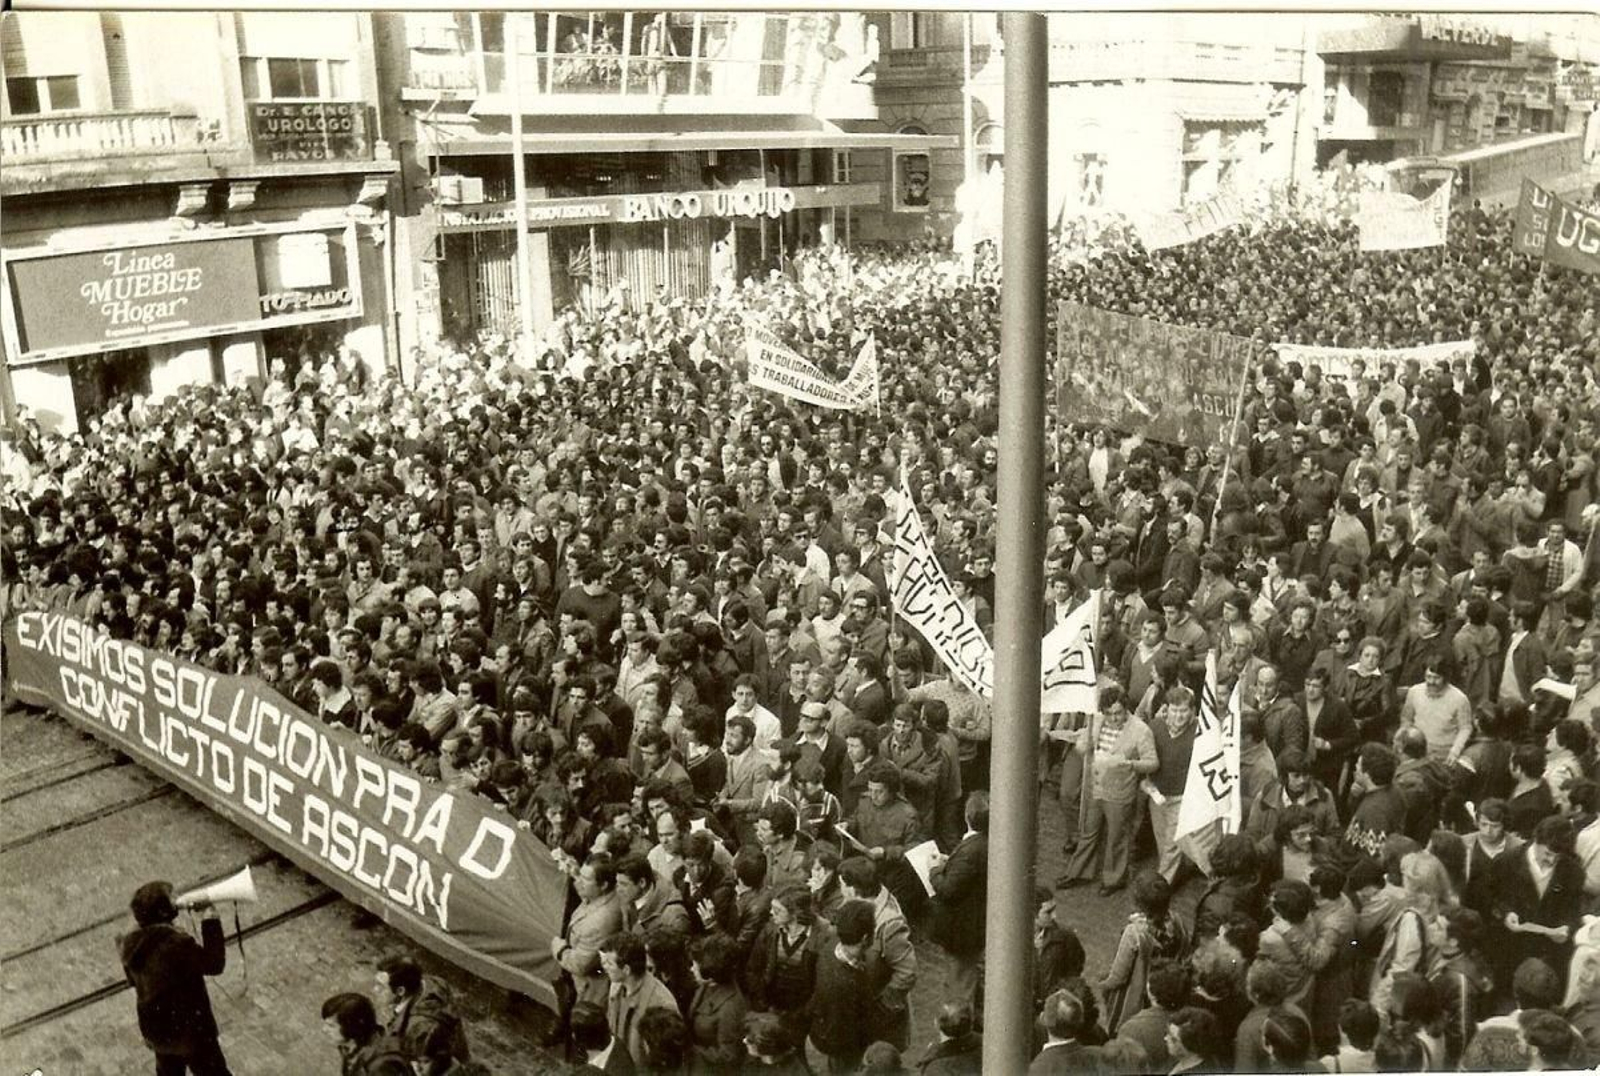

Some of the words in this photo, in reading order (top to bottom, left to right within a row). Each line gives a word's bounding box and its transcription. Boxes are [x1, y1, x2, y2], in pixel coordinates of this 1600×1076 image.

[267, 117, 352, 132] UROLOGO
[624, 193, 702, 220] BANCO
[80, 268, 203, 305] MUEBLE
[101, 297, 189, 325] Hogar
[760, 348, 773, 362] EN
[17, 612, 145, 694] EXISIMOS
[153, 658, 347, 798] SOLUCION
[353, 756, 456, 853] PRA
[60, 667, 235, 794] CONFLICTO
[242, 756, 295, 836] DE
[301, 794, 452, 931] ASCON
